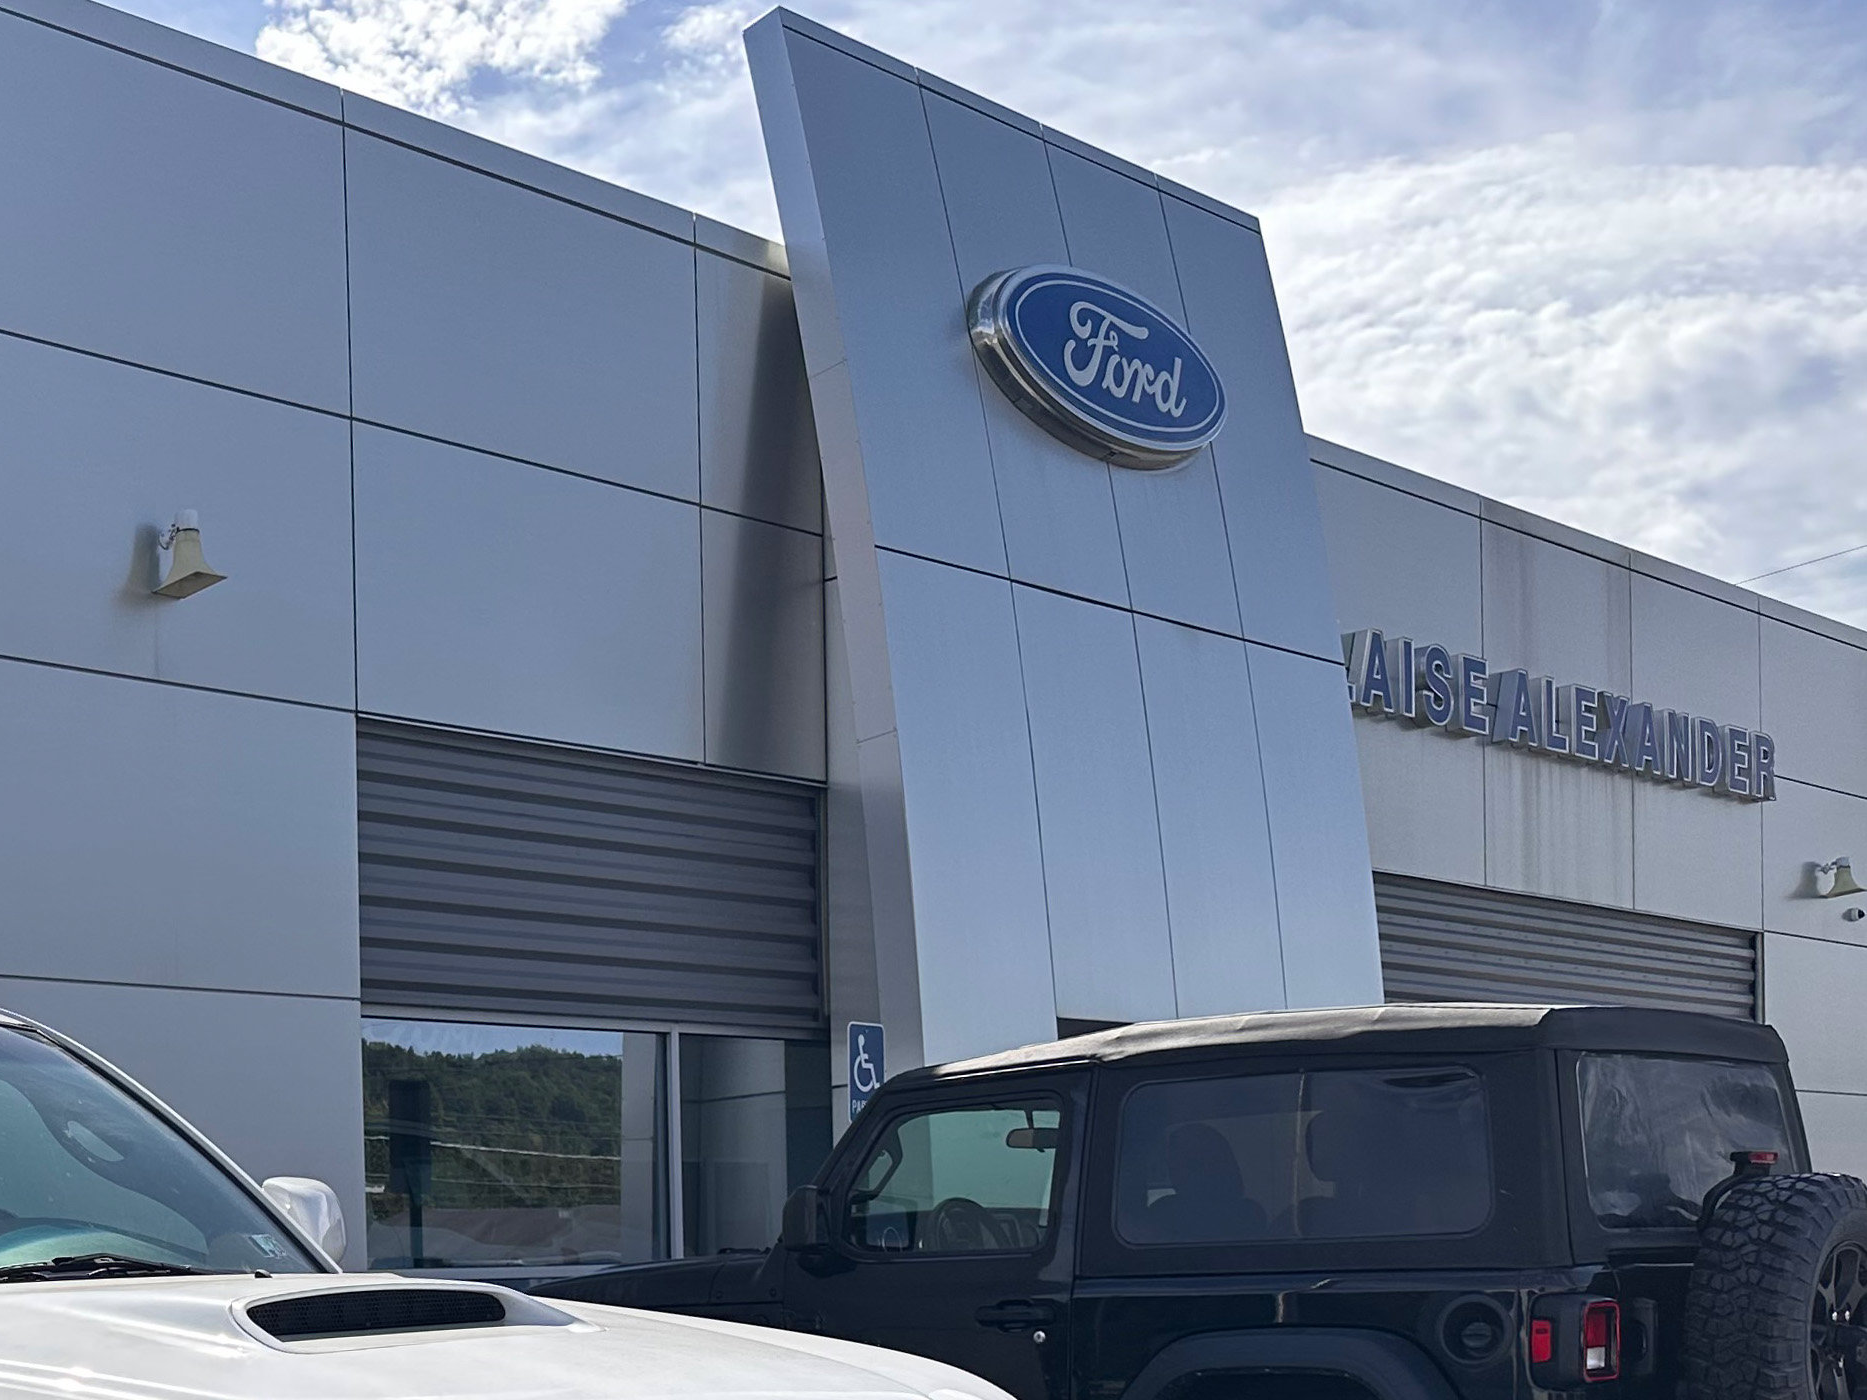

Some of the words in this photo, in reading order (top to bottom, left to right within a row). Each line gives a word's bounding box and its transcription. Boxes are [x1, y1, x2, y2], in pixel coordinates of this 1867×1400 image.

[1063, 300, 1187, 418] Ford
[1341, 628, 1490, 738] AISE
[1492, 668, 1776, 801] ALEXANDER
